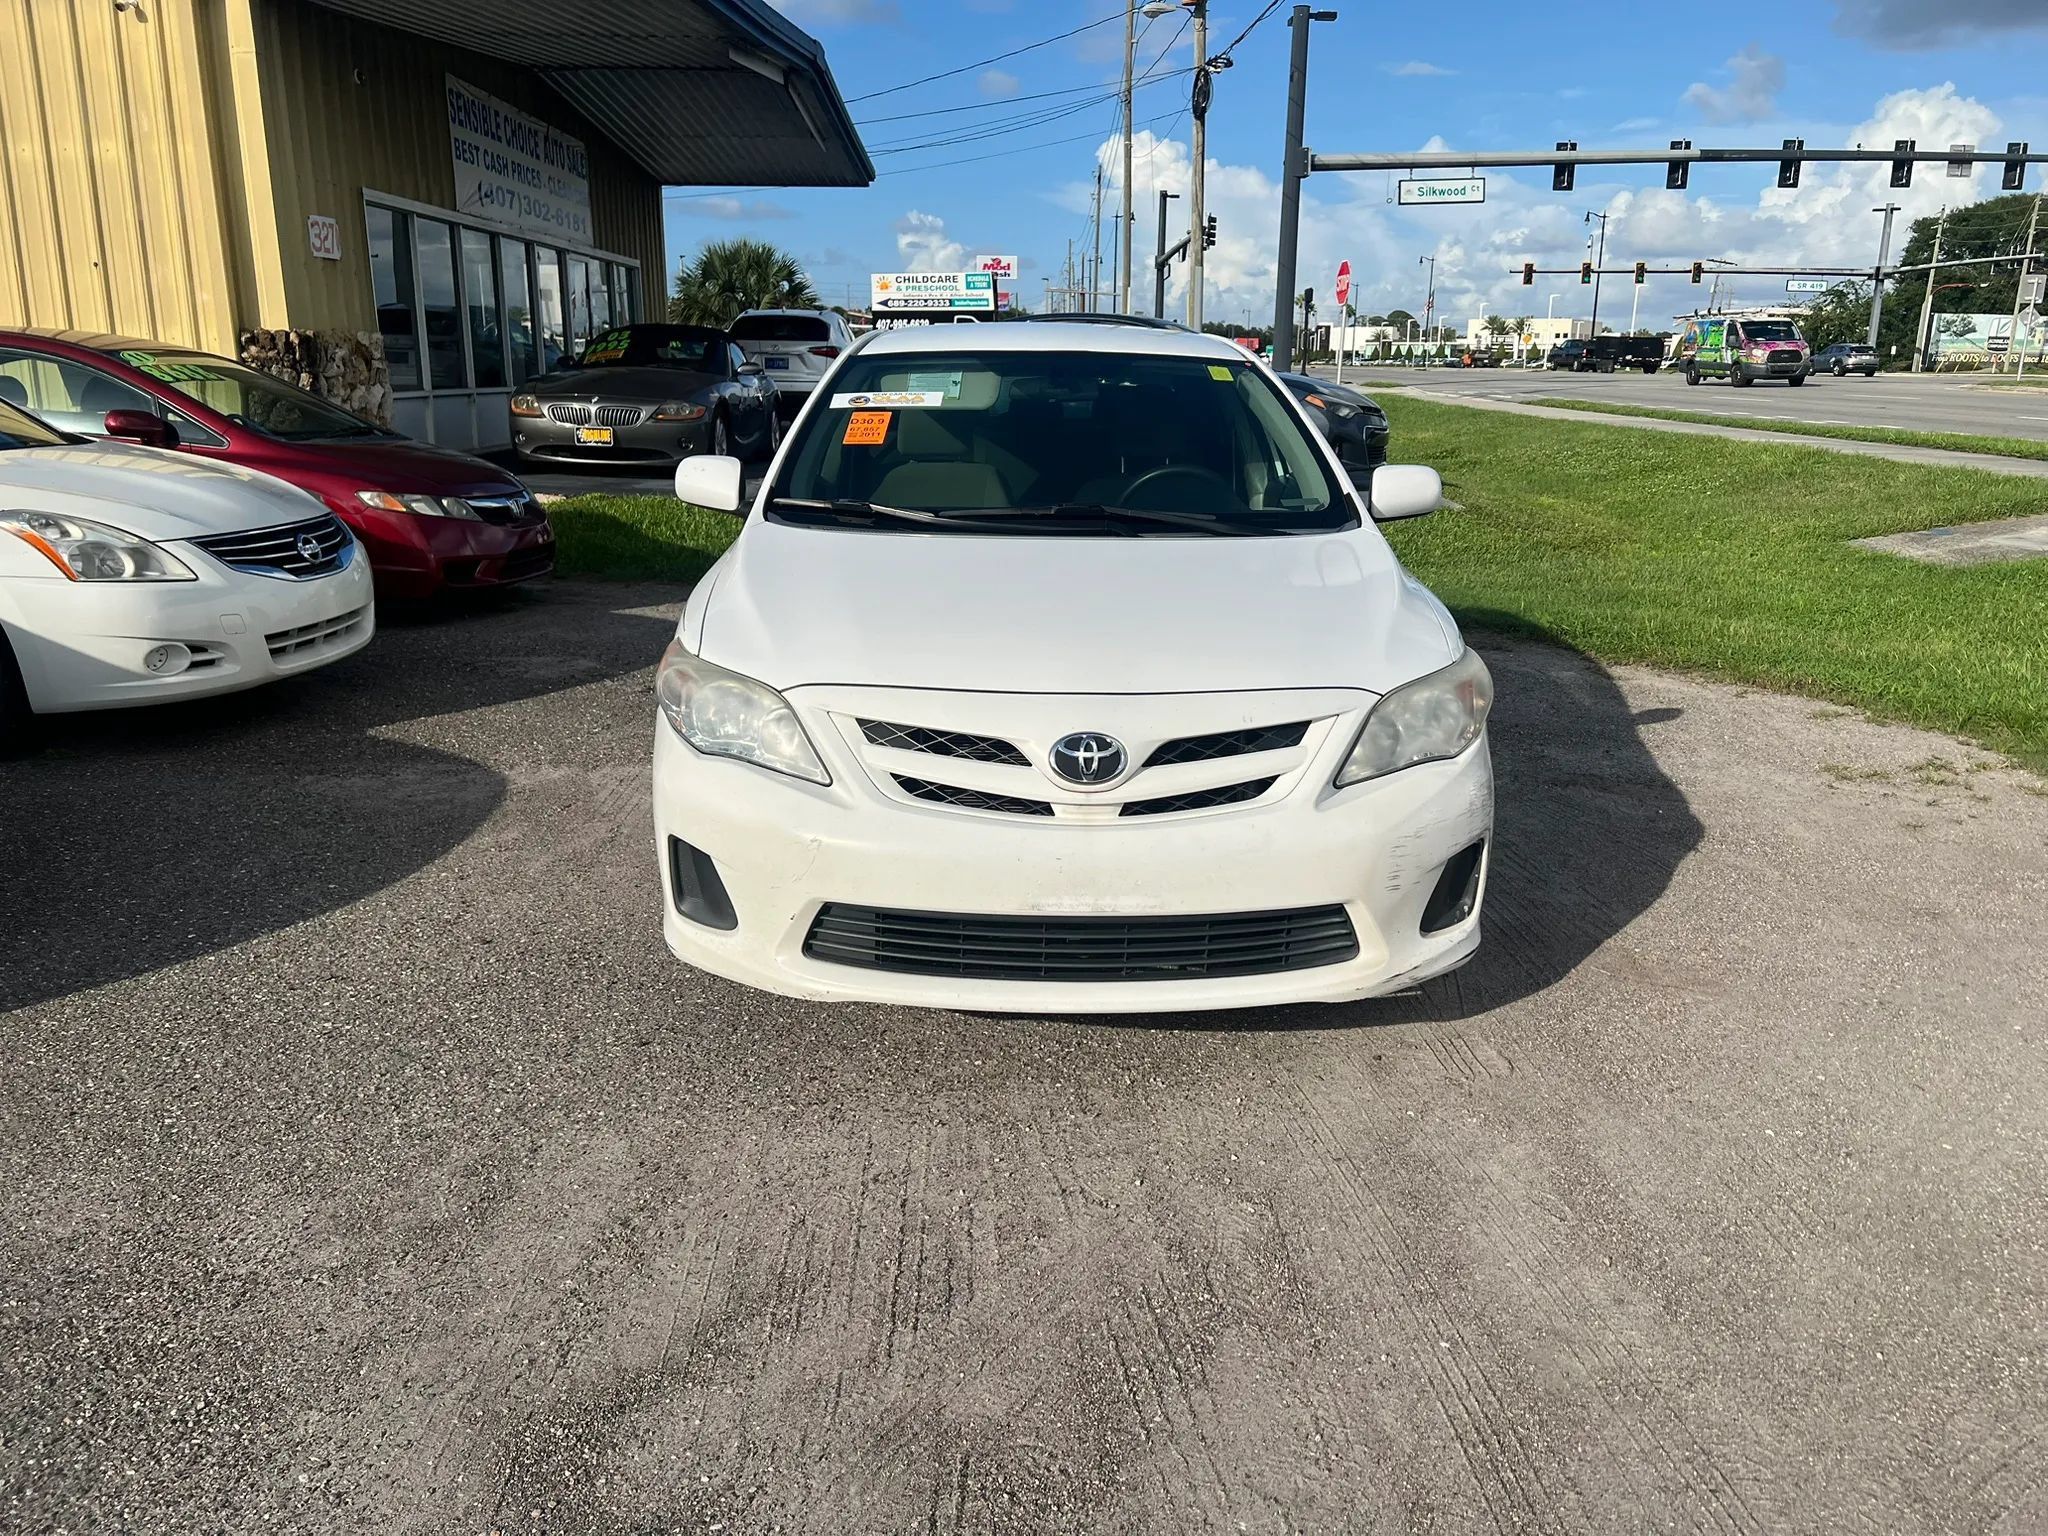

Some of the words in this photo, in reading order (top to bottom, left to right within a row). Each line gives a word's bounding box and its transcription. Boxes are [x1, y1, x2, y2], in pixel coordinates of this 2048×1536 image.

[447, 87, 503, 143] SENSIBLE
[503, 114, 540, 161] CHOICE
[543, 133, 566, 171] AUTO
[453, 137, 481, 168] BEST
[483, 148, 510, 178] CASH
[511, 160, 542, 189] PRICES
[1417, 186, 1466, 197] Silkwood
[478, 181, 587, 235] (407)302-6181
[895, 275, 959, 284] CHILDCARE
[905, 284, 960, 292] PRESCHOOL
[887, 299, 950, 307] 689-220-9333
[1950, 353, 1980, 362] ROOTS
